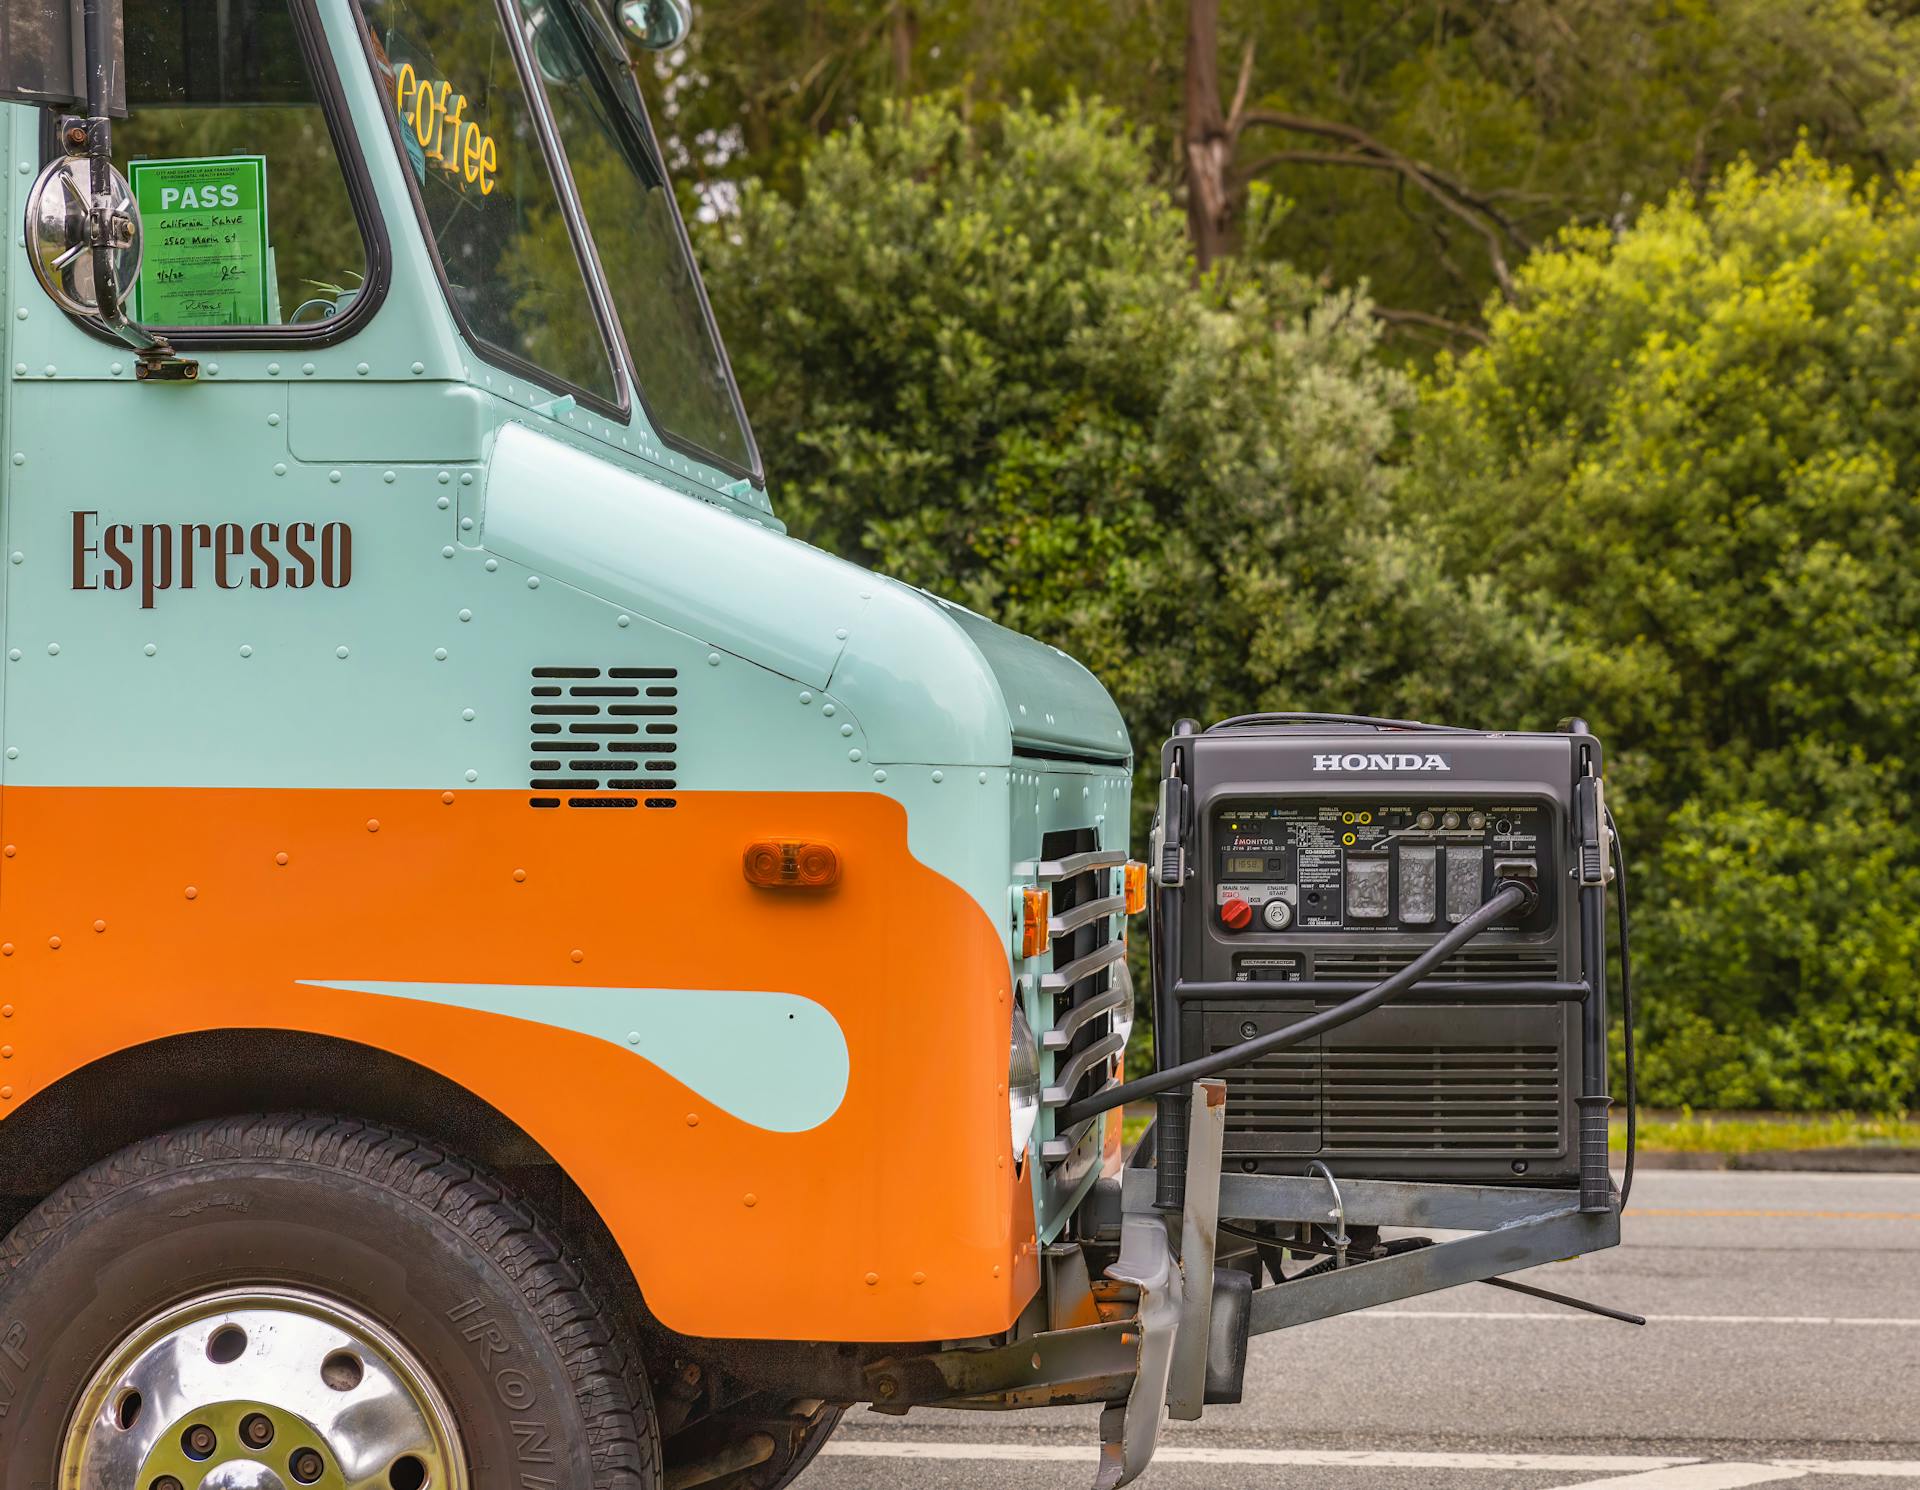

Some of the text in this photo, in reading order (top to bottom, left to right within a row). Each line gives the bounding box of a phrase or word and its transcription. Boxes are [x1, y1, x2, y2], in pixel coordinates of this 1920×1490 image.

[161, 184, 239, 210] PASS
[70, 511, 352, 609] Espresso
[1313, 754, 1450, 770] HONDA
